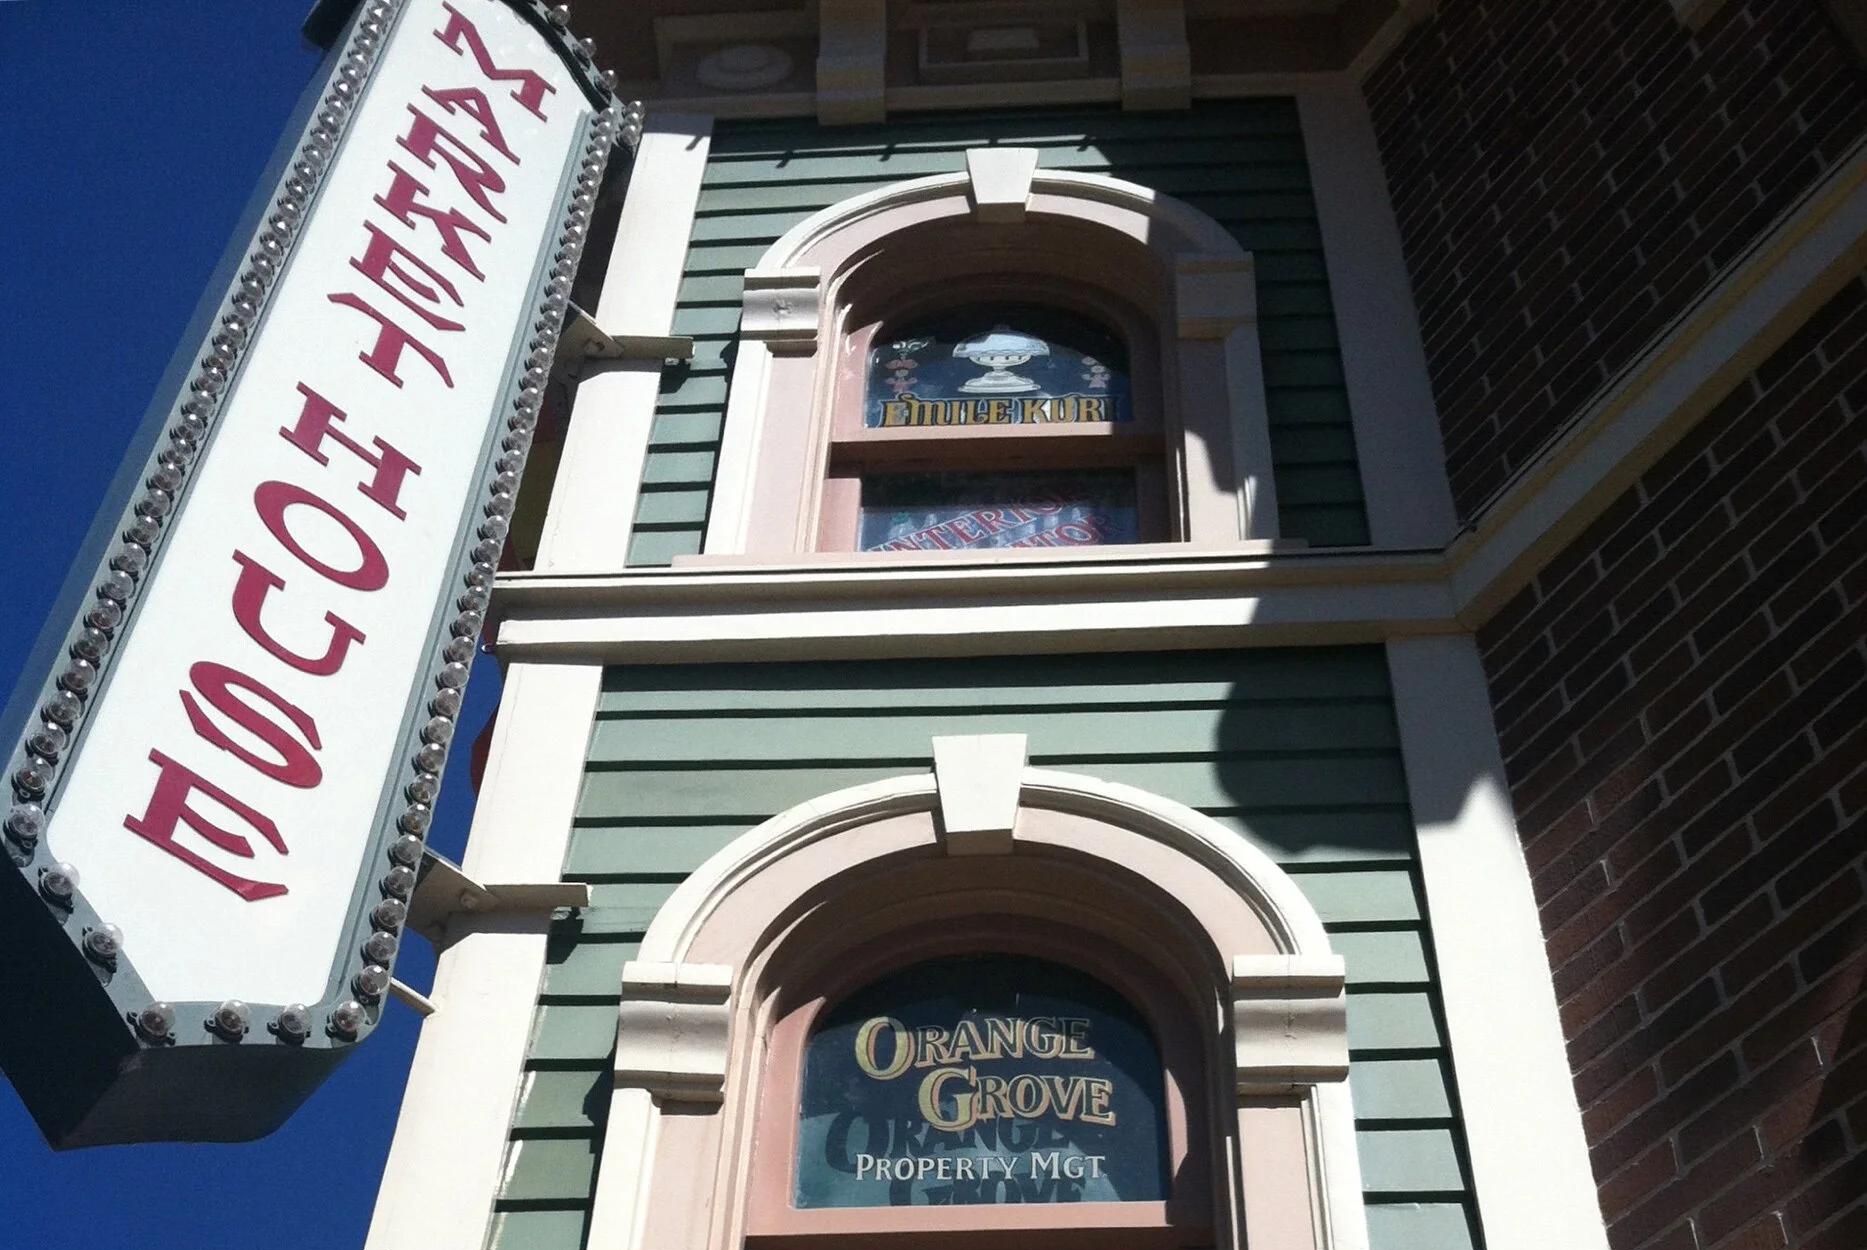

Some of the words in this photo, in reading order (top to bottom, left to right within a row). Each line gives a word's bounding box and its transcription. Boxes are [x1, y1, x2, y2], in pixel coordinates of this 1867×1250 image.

[327, 1, 557, 390] MARKET
[883, 393, 1012, 427] EMILE
[1022, 395, 1114, 424] KURI
[124, 382, 423, 903] HOUSE
[855, 1016, 1095, 1080] ORANGE
[918, 1066, 1116, 1131] GROVE
[855, 1153, 1019, 1181] PROPERTY
